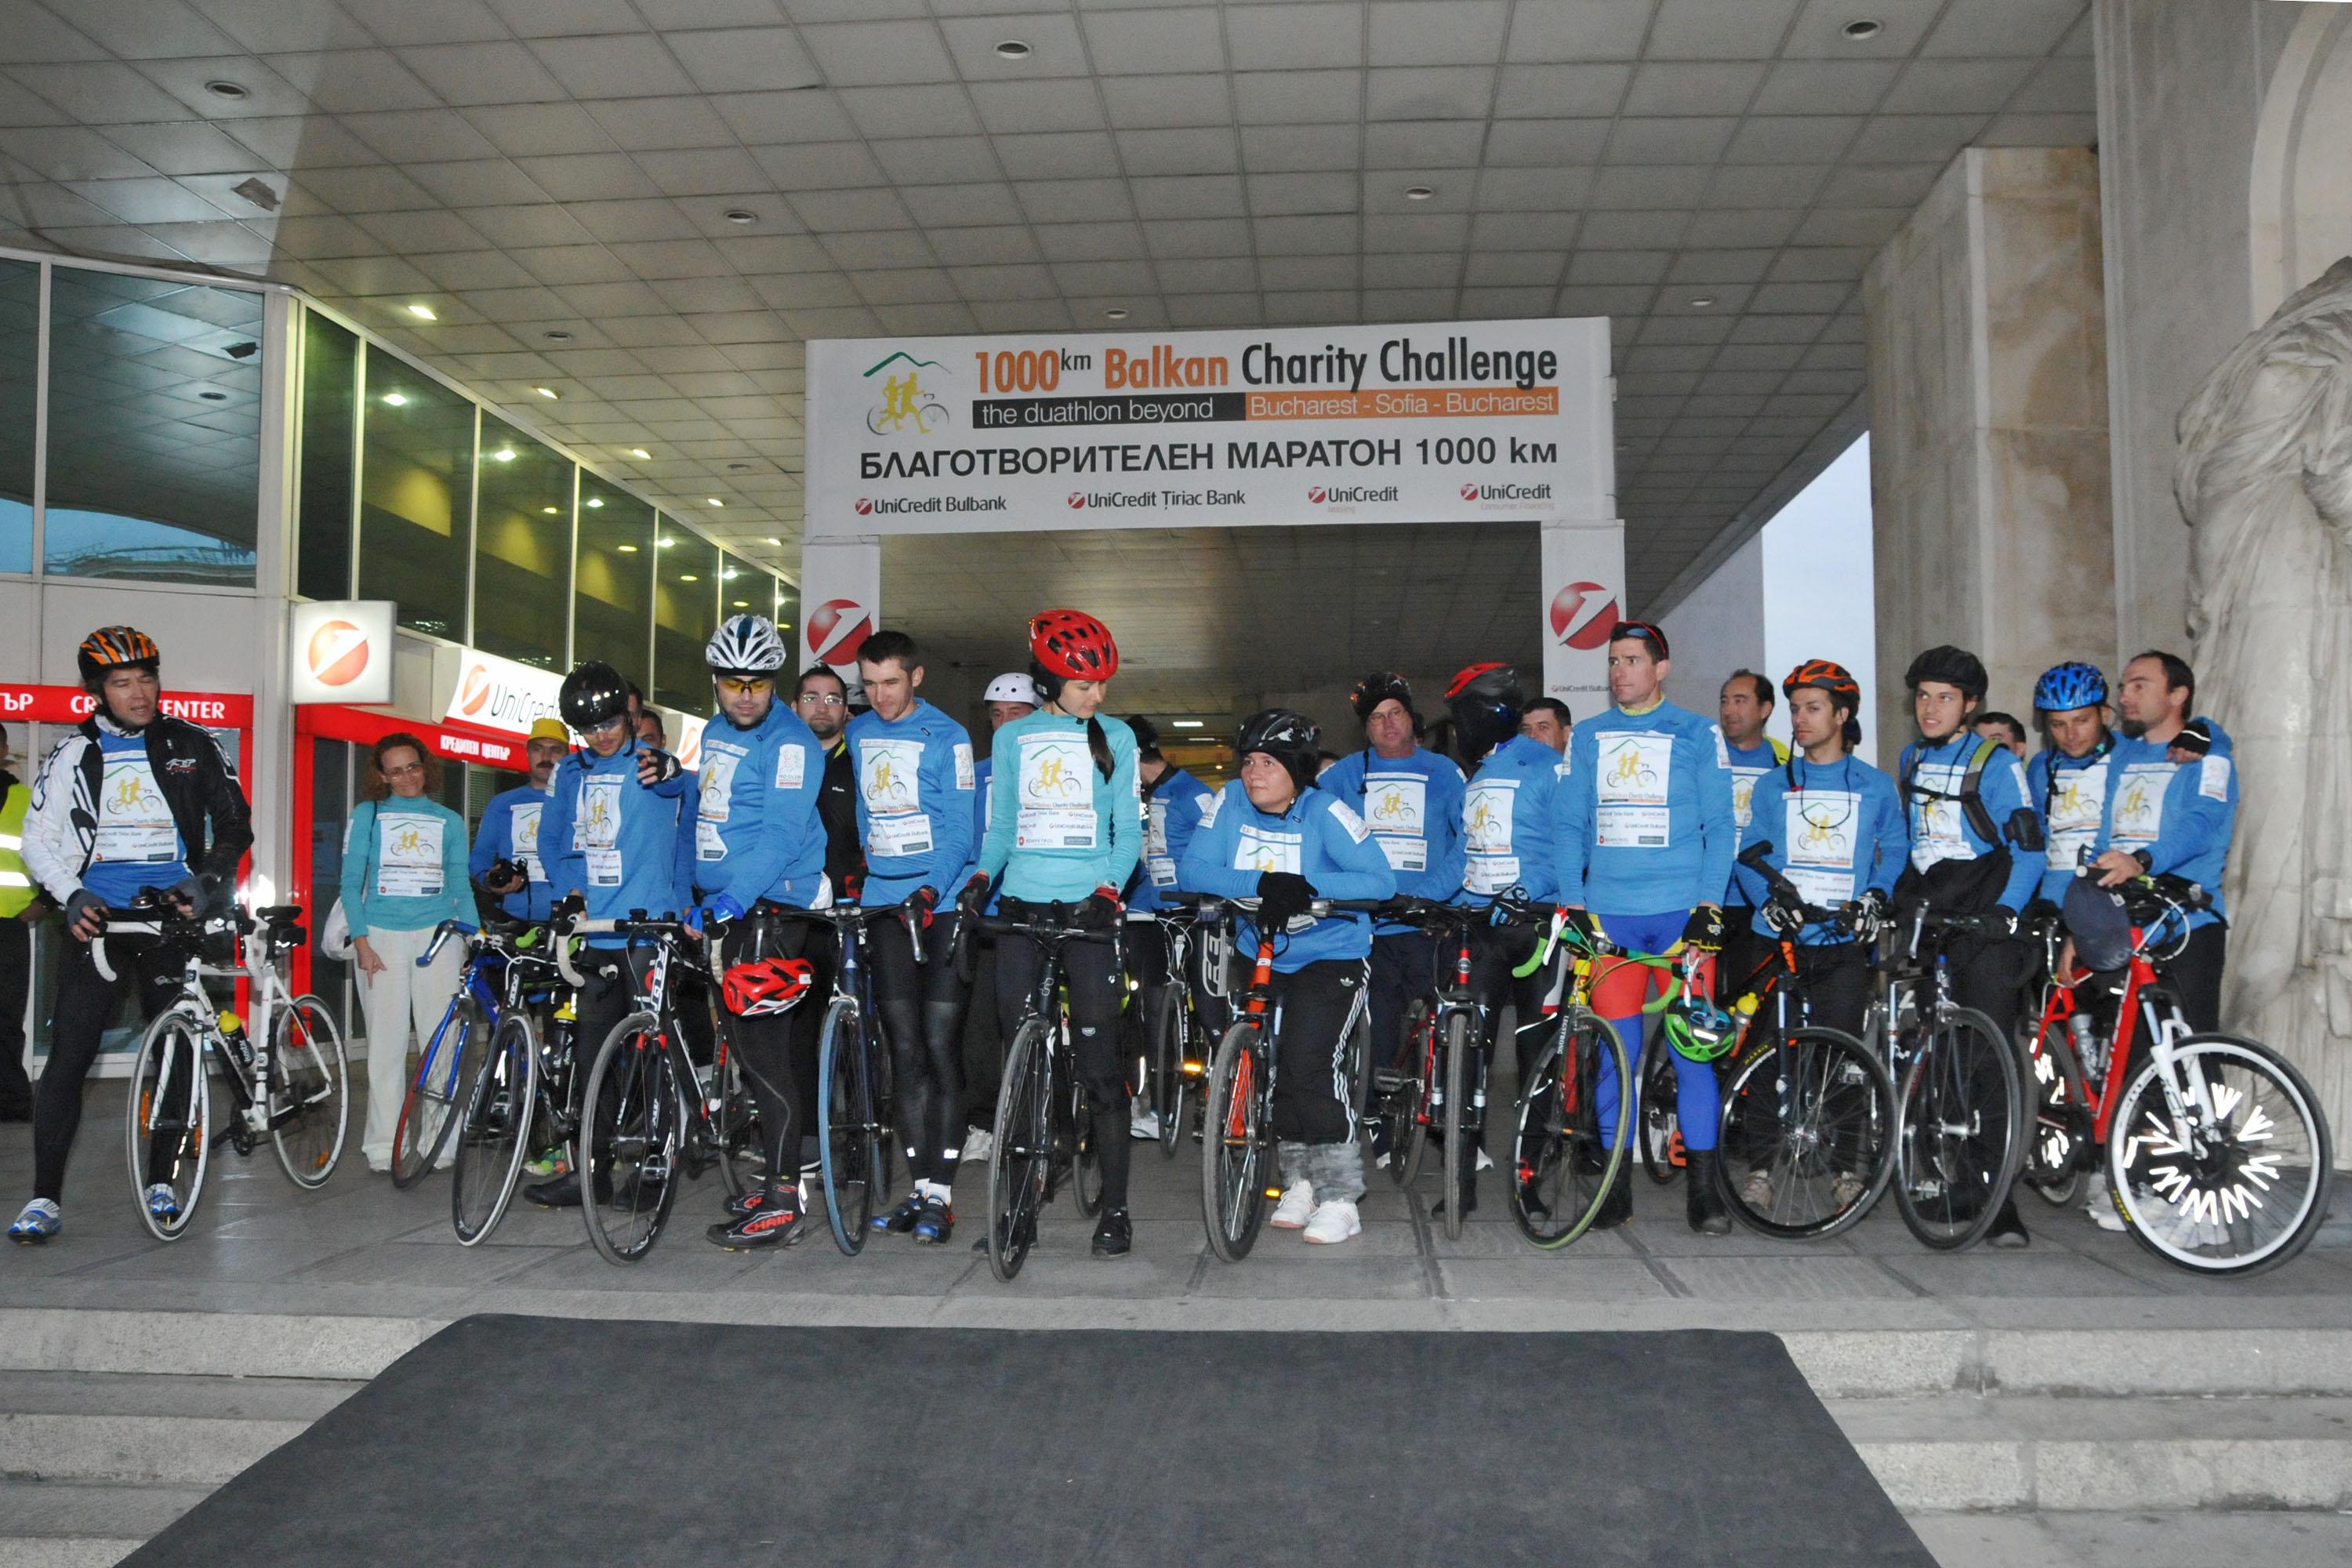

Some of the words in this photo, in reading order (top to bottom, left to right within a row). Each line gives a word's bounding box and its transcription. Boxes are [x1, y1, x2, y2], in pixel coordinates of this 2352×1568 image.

[1105, 345, 1229, 390] Balkan
[1242, 343, 1367, 394] Charity
[1380, 336, 1557, 390] Challenge
[982, 404, 1018, 425] the
[1024, 400, 1121, 423] duathlon
[1129, 396, 1214, 424] beyond
[1250, 395, 1358, 417] Bucharest
[1375, 394, 1429, 415] Sofia
[1446, 391, 1555, 413] Bucharest
[860, 442, 1214, 480] БЛАГОТВОРИТЕЛЕН
[1227, 438, 1401, 470] МАРАТОН
[1415, 436, 1496, 465] 1000
[1087, 492, 1156, 508] UniCredit
[1206, 488, 1246, 506] Bank
[1328, 485, 1399, 503] UniCredit
[1480, 483, 1552, 501] UniCredit
[874, 497, 942, 514] UniCredit
[946, 495, 1007, 513] Bulbank
[159, 699, 225, 720] ENTER
[743, 1212, 794, 1234] CHAIN
